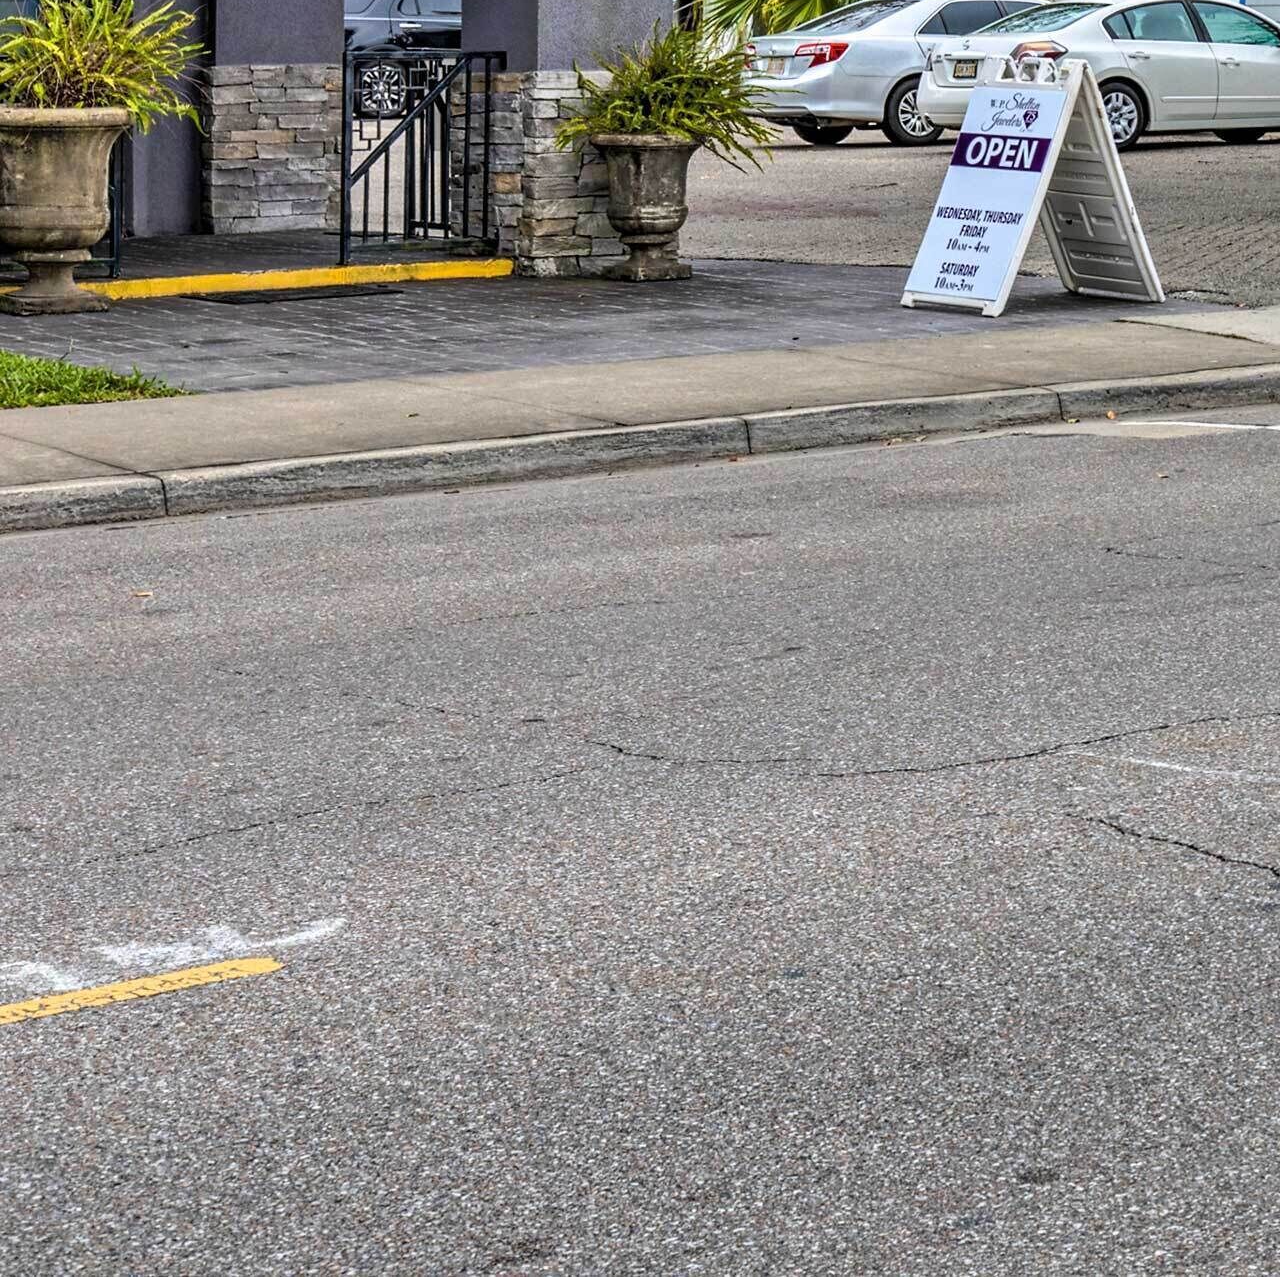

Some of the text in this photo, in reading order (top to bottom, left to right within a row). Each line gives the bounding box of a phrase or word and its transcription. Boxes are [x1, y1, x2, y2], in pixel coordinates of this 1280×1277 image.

[1026, 110, 1037, 123] 75
[966, 135, 1039, 169] OPEN
[936, 206, 1024, 225] WEDNESDAY, THURSDAY
[959, 224, 988, 238] FRIDAY
[940, 262, 980, 277] SATURDAY
